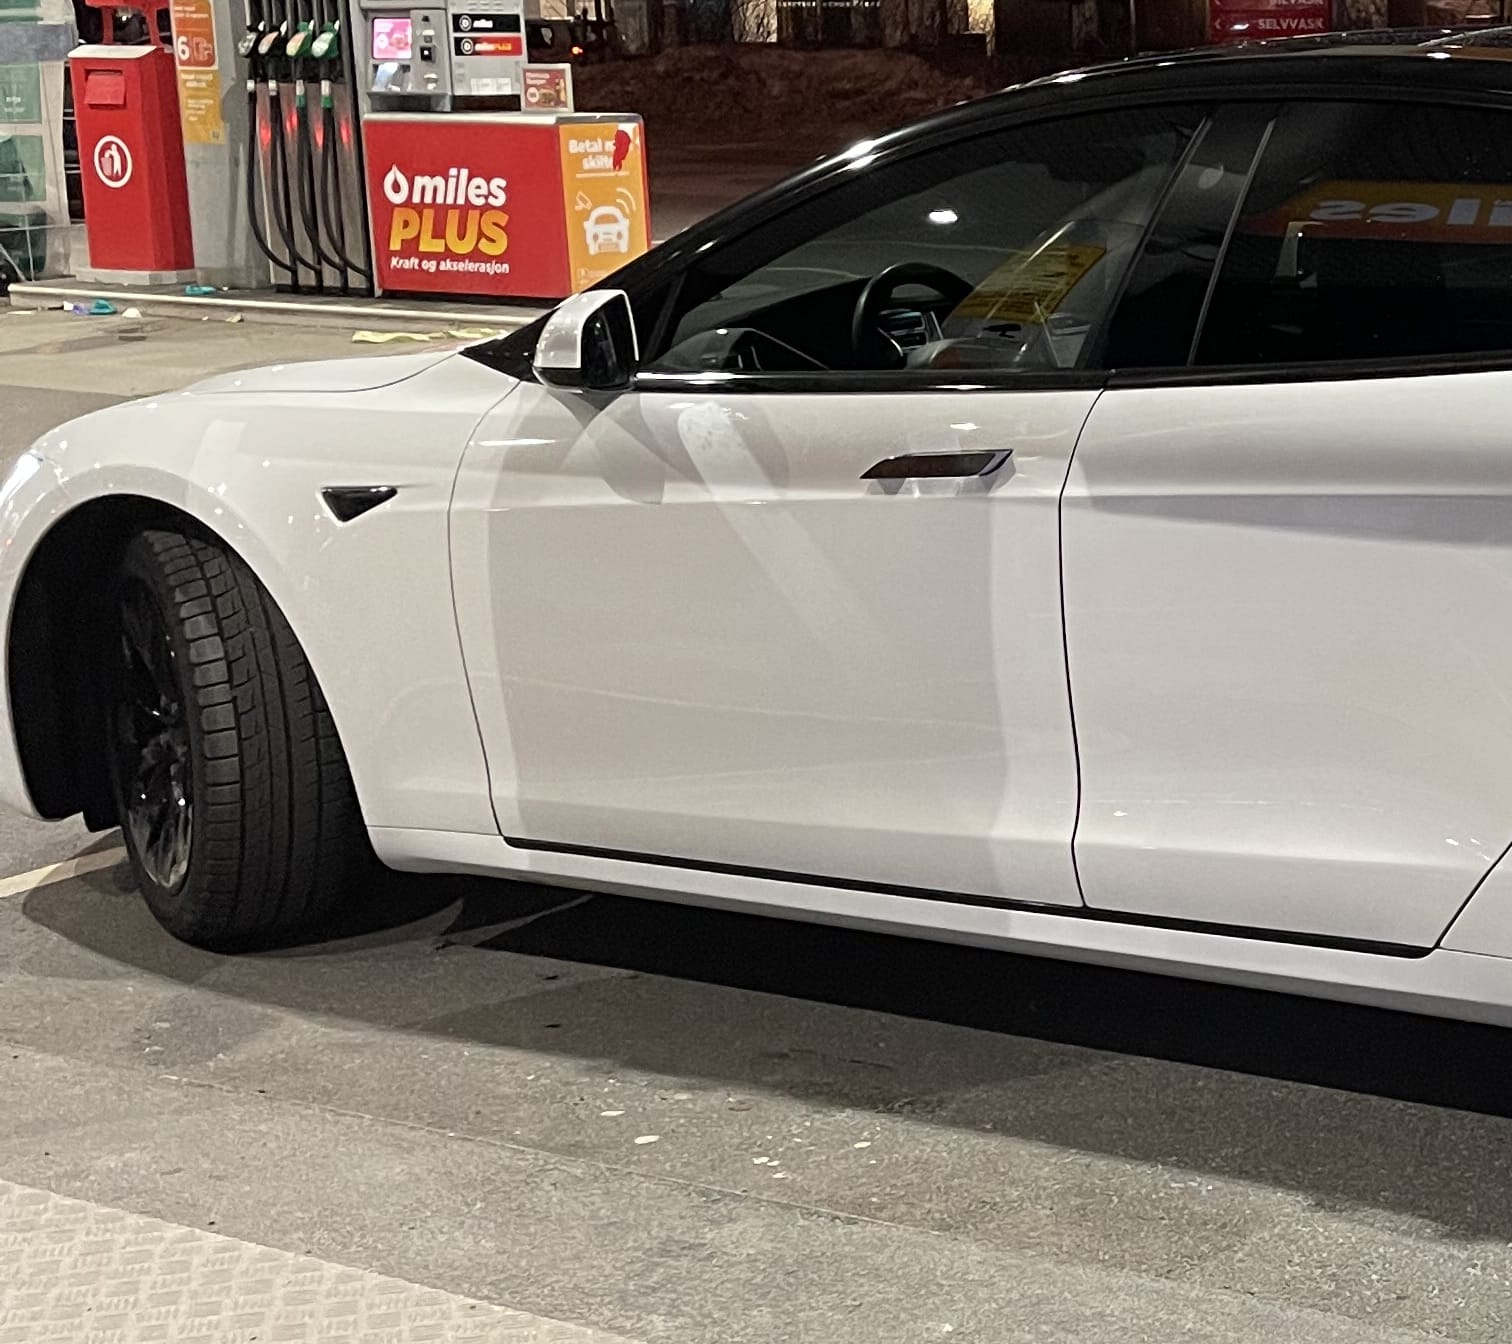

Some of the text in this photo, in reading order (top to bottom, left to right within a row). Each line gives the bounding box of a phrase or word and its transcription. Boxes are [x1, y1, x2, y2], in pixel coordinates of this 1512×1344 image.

[177, 36, 189, 61] 6
[568, 137, 603, 153] Betal
[412, 167, 507, 207] miles
[389, 207, 509, 256] PLUS
[390, 256, 510, 275] Kraft og akselerasjon
